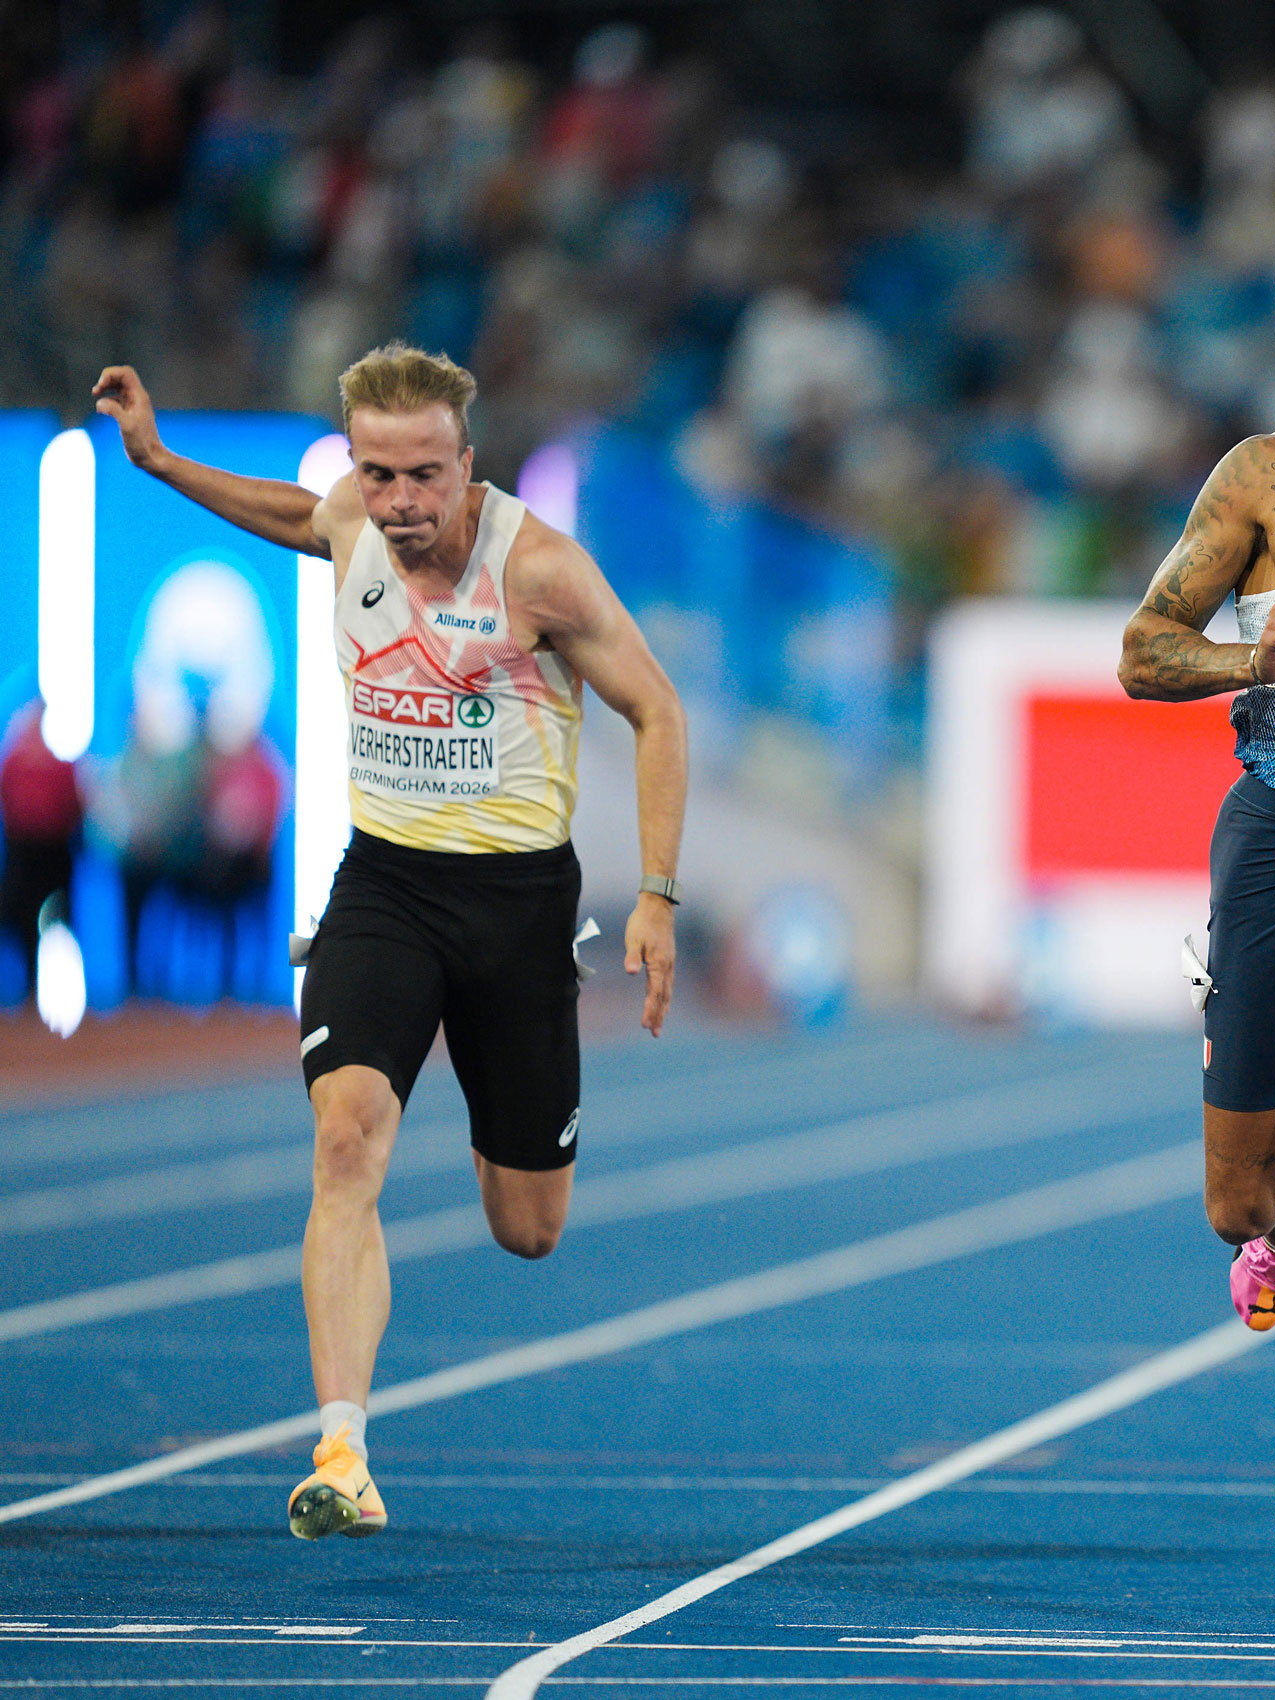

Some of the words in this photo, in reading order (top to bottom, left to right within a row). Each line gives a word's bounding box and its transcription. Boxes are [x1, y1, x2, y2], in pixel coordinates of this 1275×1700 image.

[435, 613, 476, 630] Allianz
[353, 683, 451, 725] SPAR
[351, 722, 493, 769] VERHERSTRAETEN
[350, 767, 446, 795] BIRMINGHAM
[450, 781, 491, 795] 2026
